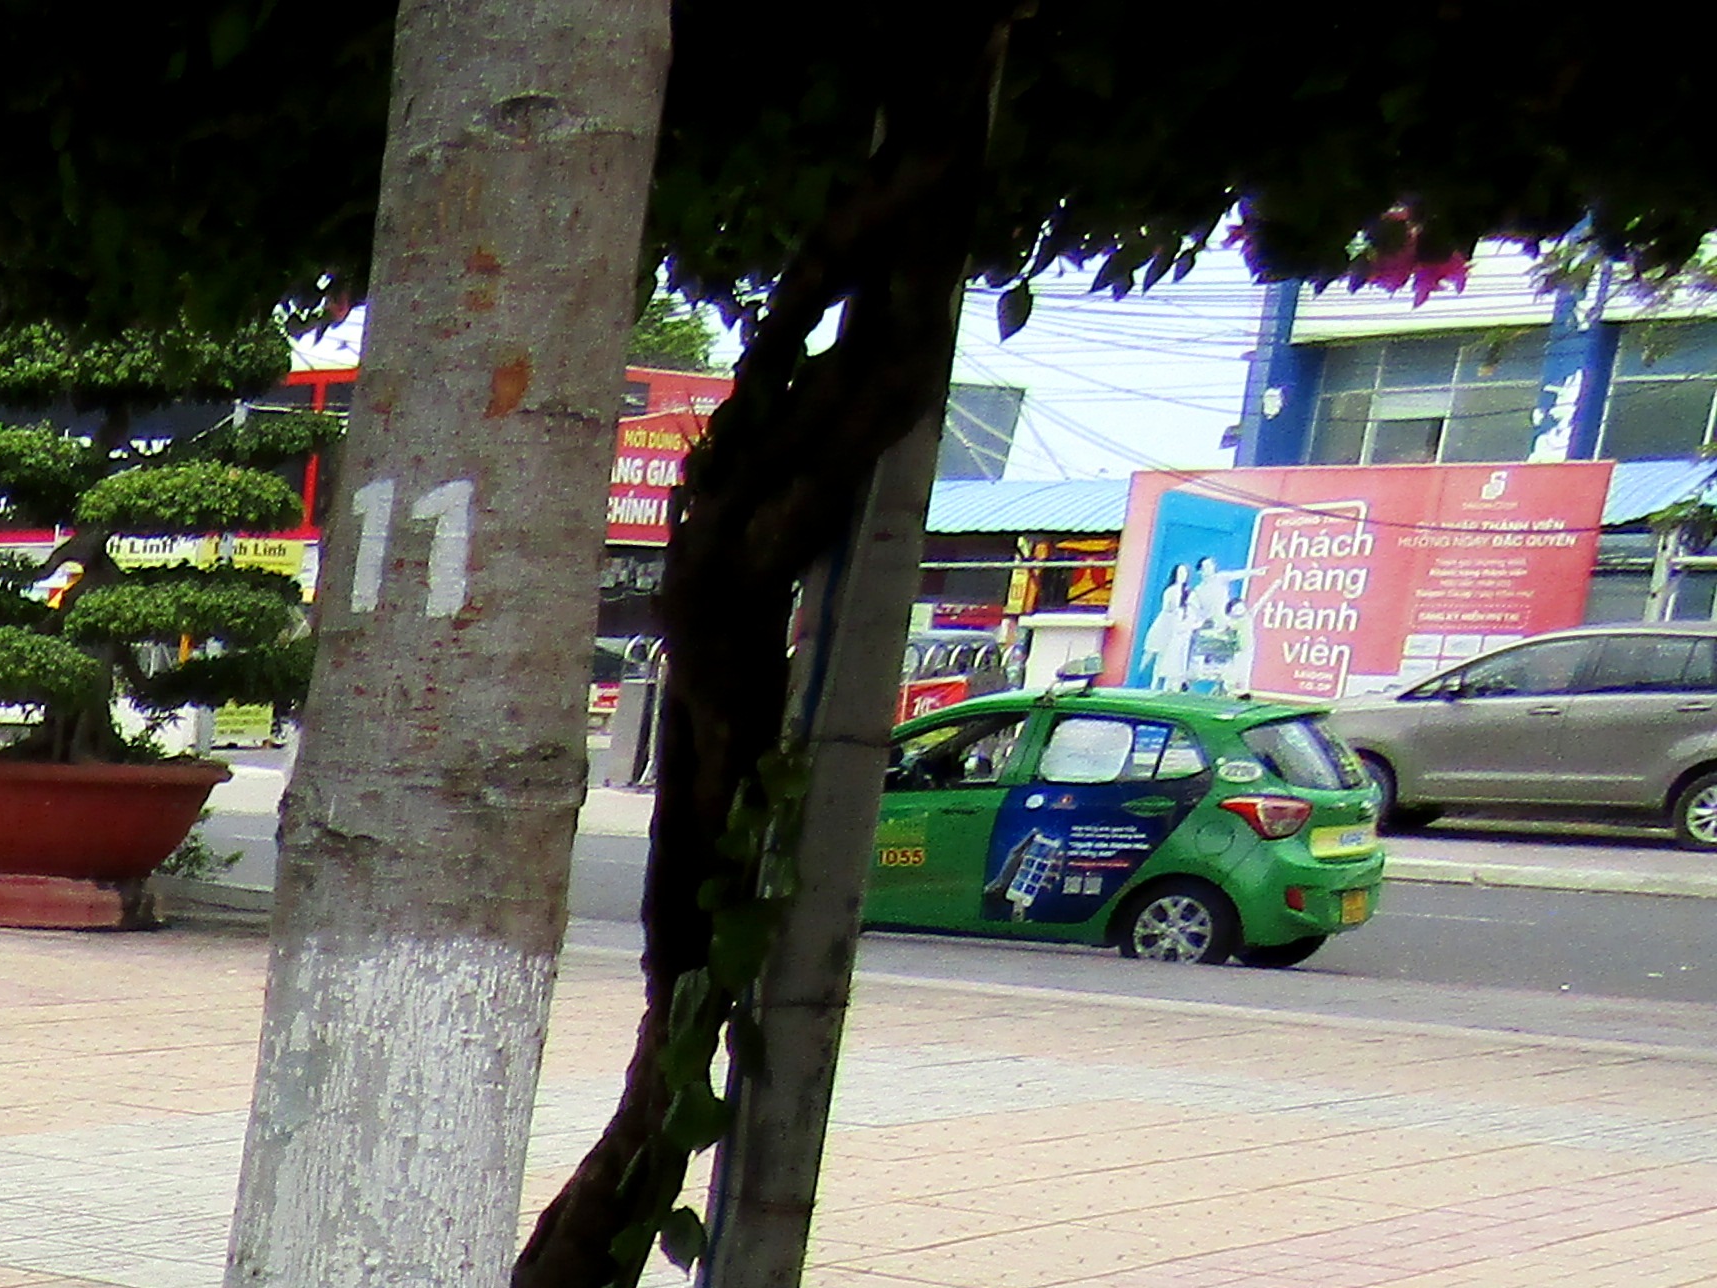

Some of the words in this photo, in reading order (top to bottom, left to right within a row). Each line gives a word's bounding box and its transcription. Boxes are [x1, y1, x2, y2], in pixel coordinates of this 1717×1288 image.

[350, 478, 474, 619] 11
[1268, 529, 1374, 560] khách
[1281, 562, 1369, 599] hàng
[1263, 601, 1359, 632] thành
[1282, 635, 1350, 667] viên
